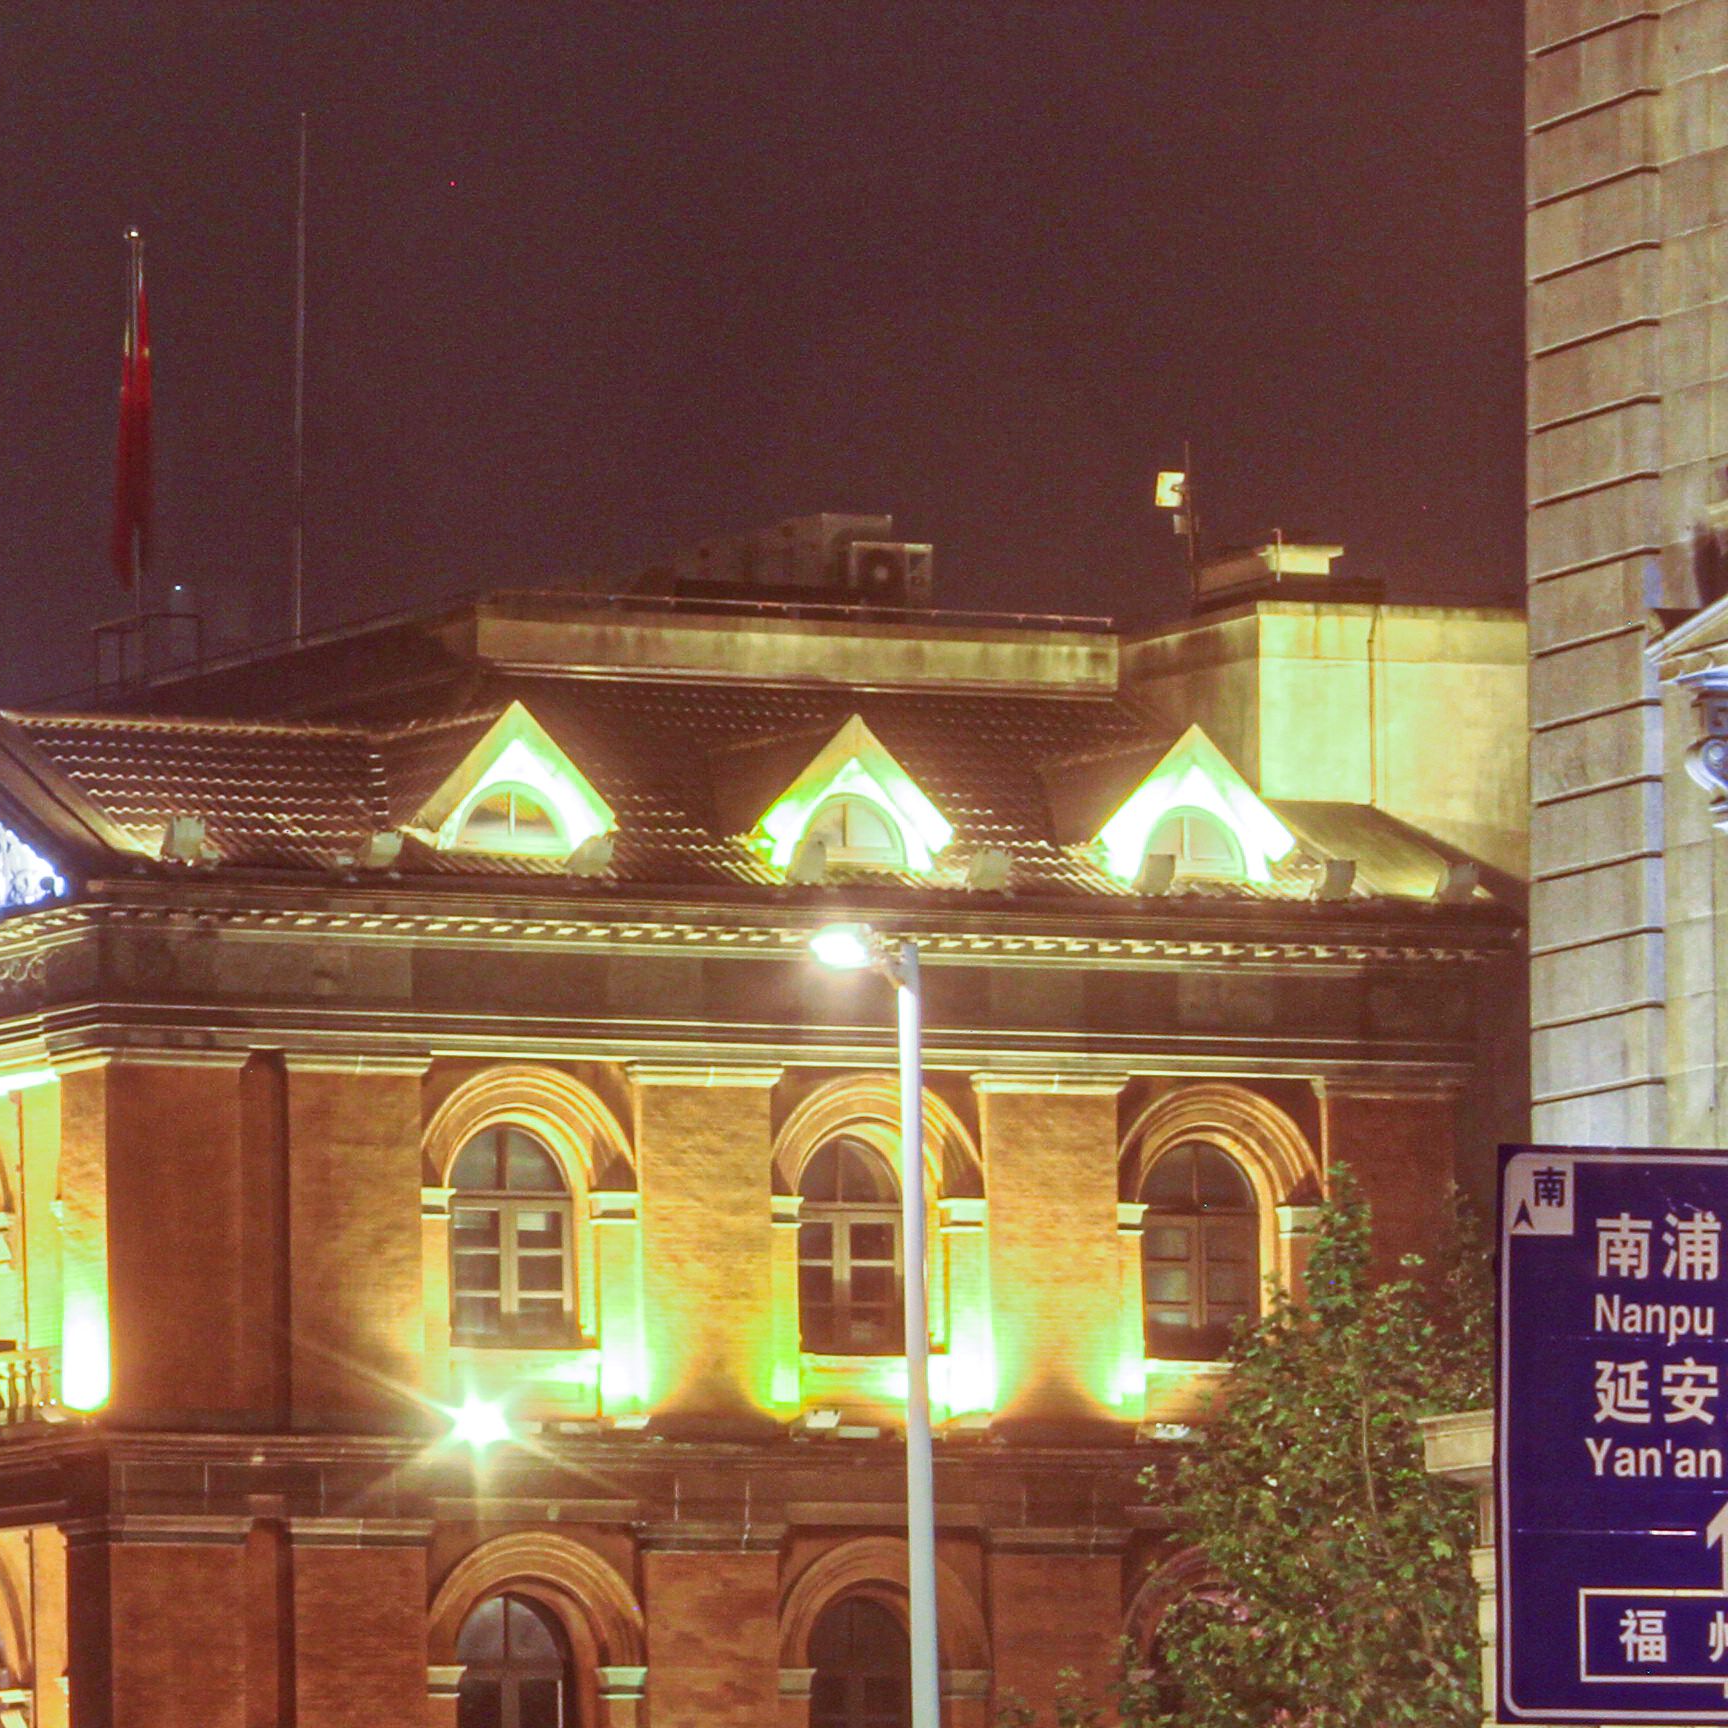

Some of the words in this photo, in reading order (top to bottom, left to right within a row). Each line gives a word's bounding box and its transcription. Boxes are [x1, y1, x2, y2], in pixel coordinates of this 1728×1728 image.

[1532, 1167, 1567, 1208] 南
[1595, 1211, 1721, 1281] 南浦
[1594, 1294, 1714, 1345] Nanpu
[1594, 1357, 1719, 1425] 延安
[1585, 1438, 1722, 1479] Yan'an
